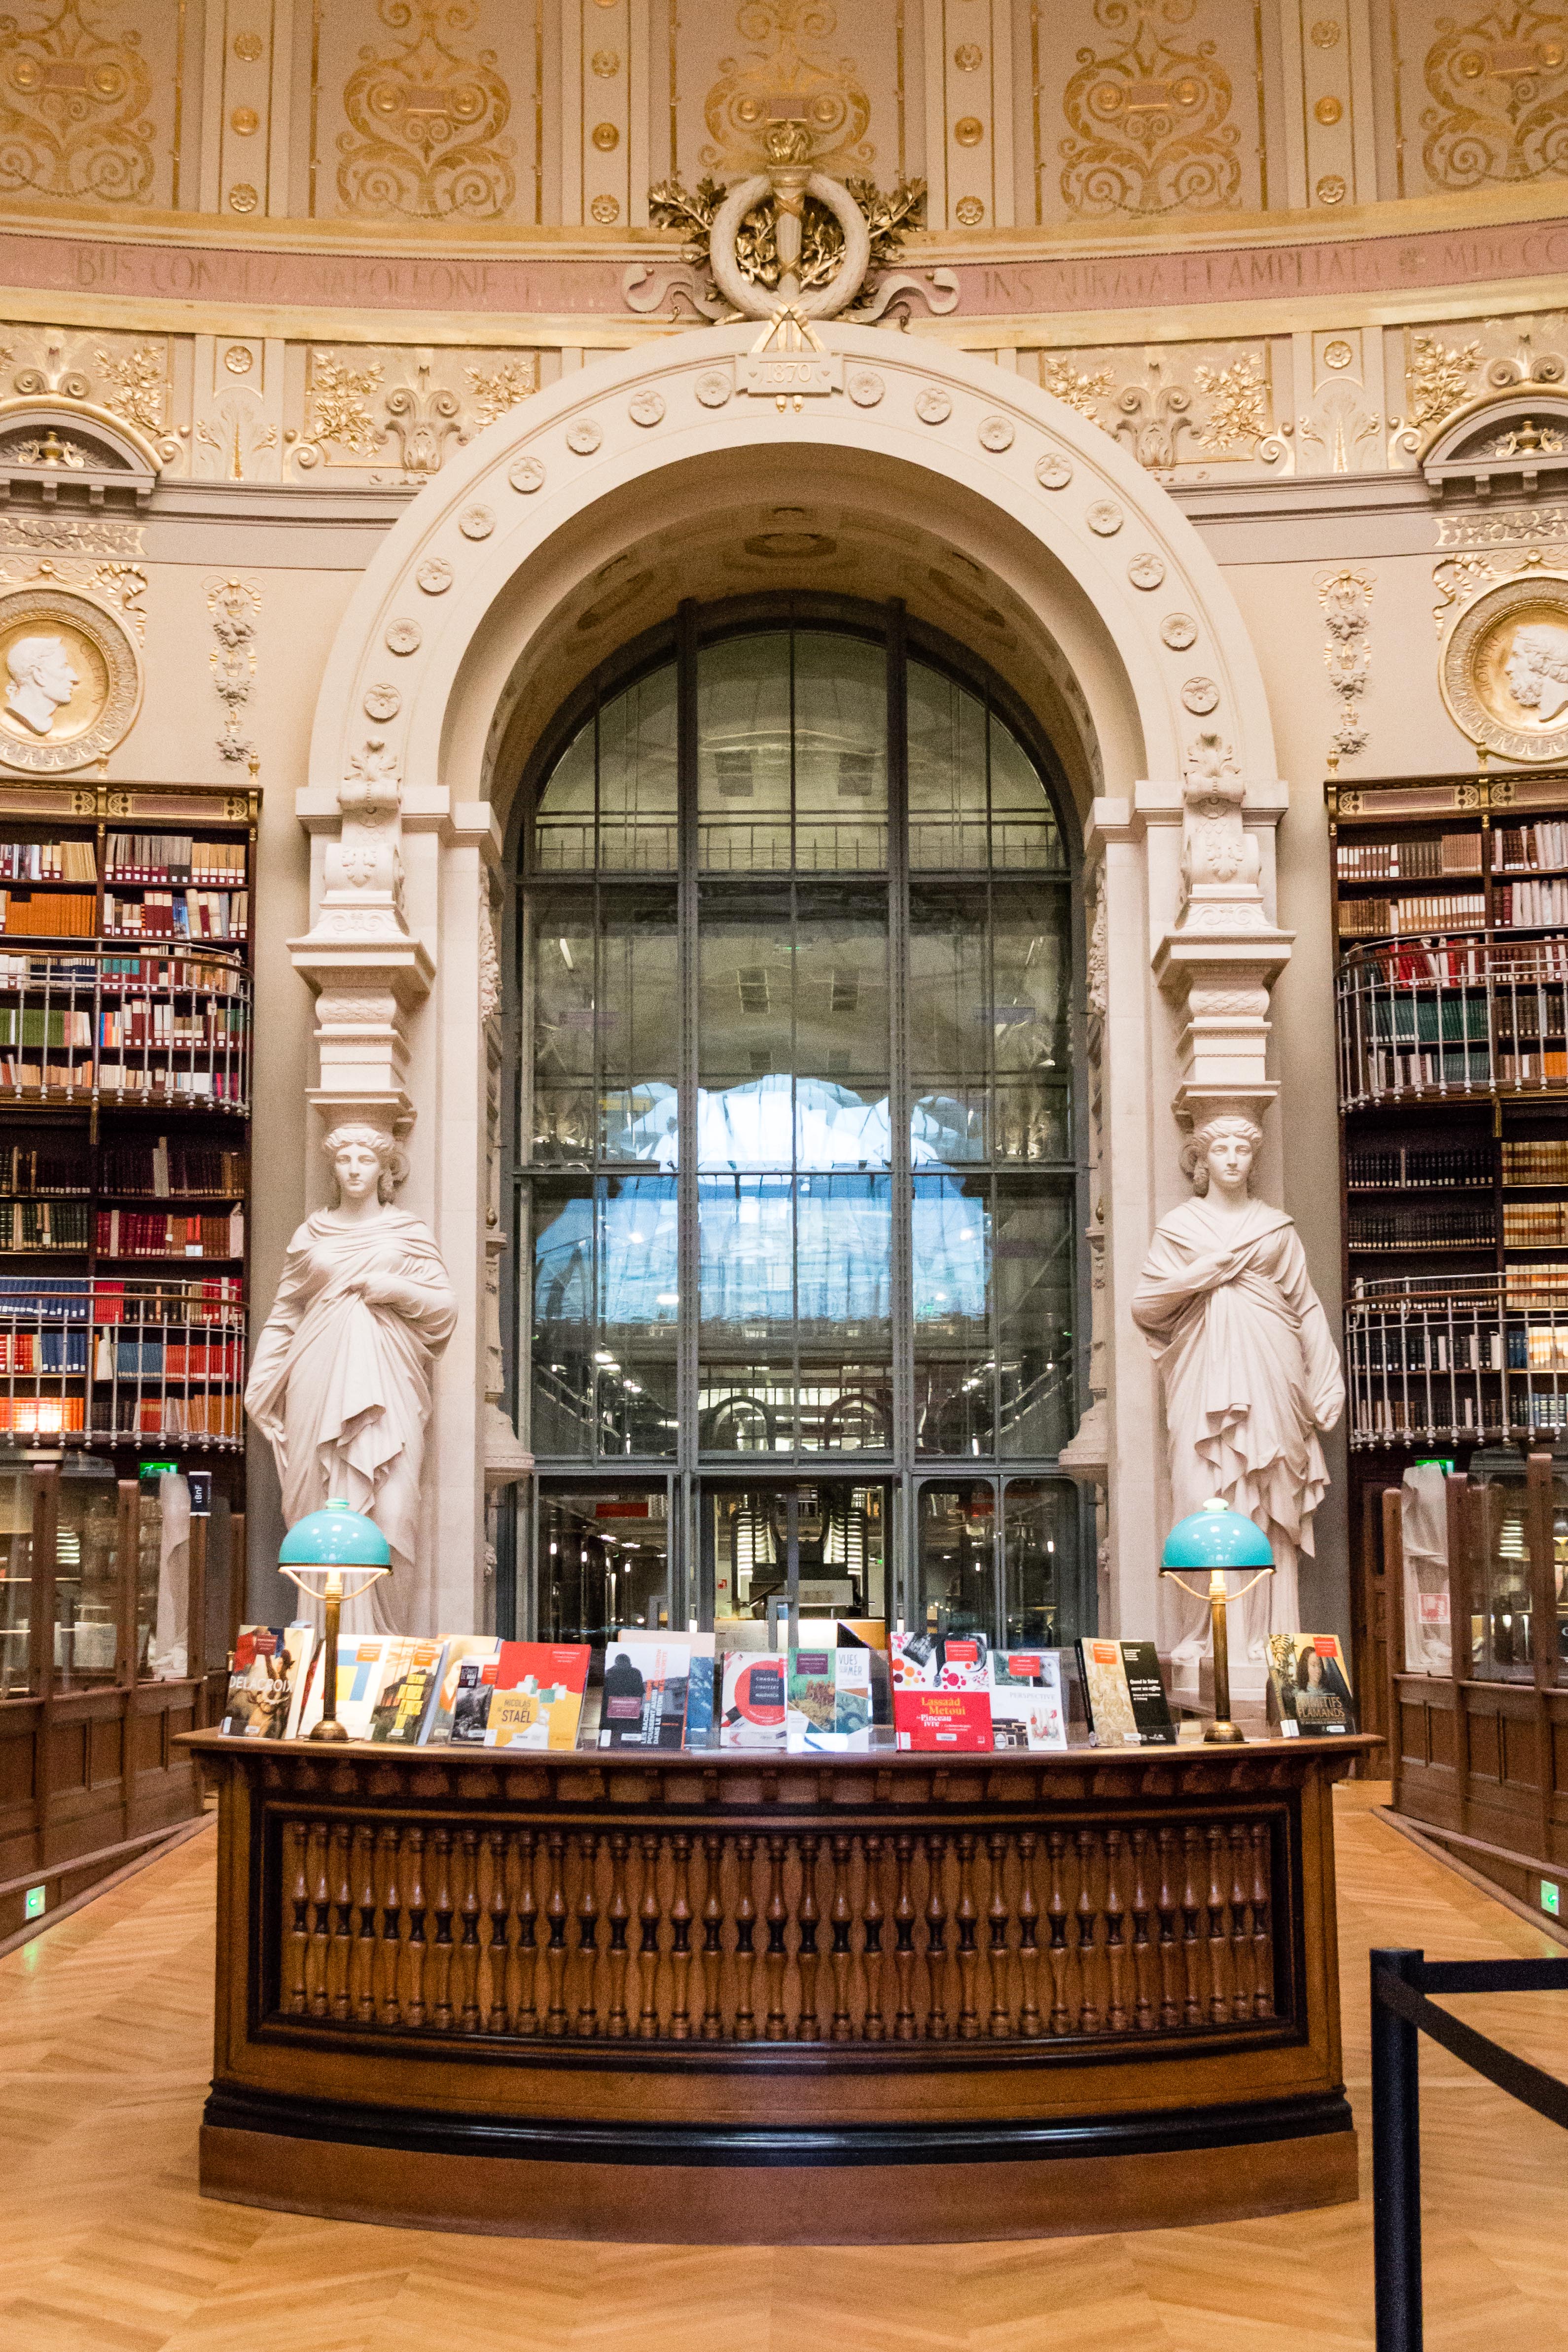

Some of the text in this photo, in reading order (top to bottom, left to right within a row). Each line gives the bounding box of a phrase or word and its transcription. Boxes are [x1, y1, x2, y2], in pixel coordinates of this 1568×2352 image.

[765, 362, 811, 384] 1870
[838, 1653, 858, 1666] VUES
[848, 1665, 862, 1676] MER
[229, 1675, 295, 1693] DELACROIX
[1010, 1692, 1056, 1700] PERSPECTIVE
[504, 1699, 532, 1708] NICOLAS
[501, 1707, 532, 1723] STAËL
[929, 1706, 966, 1715] Metoui
[1297, 1708, 1346, 1718] FLAMANDS
